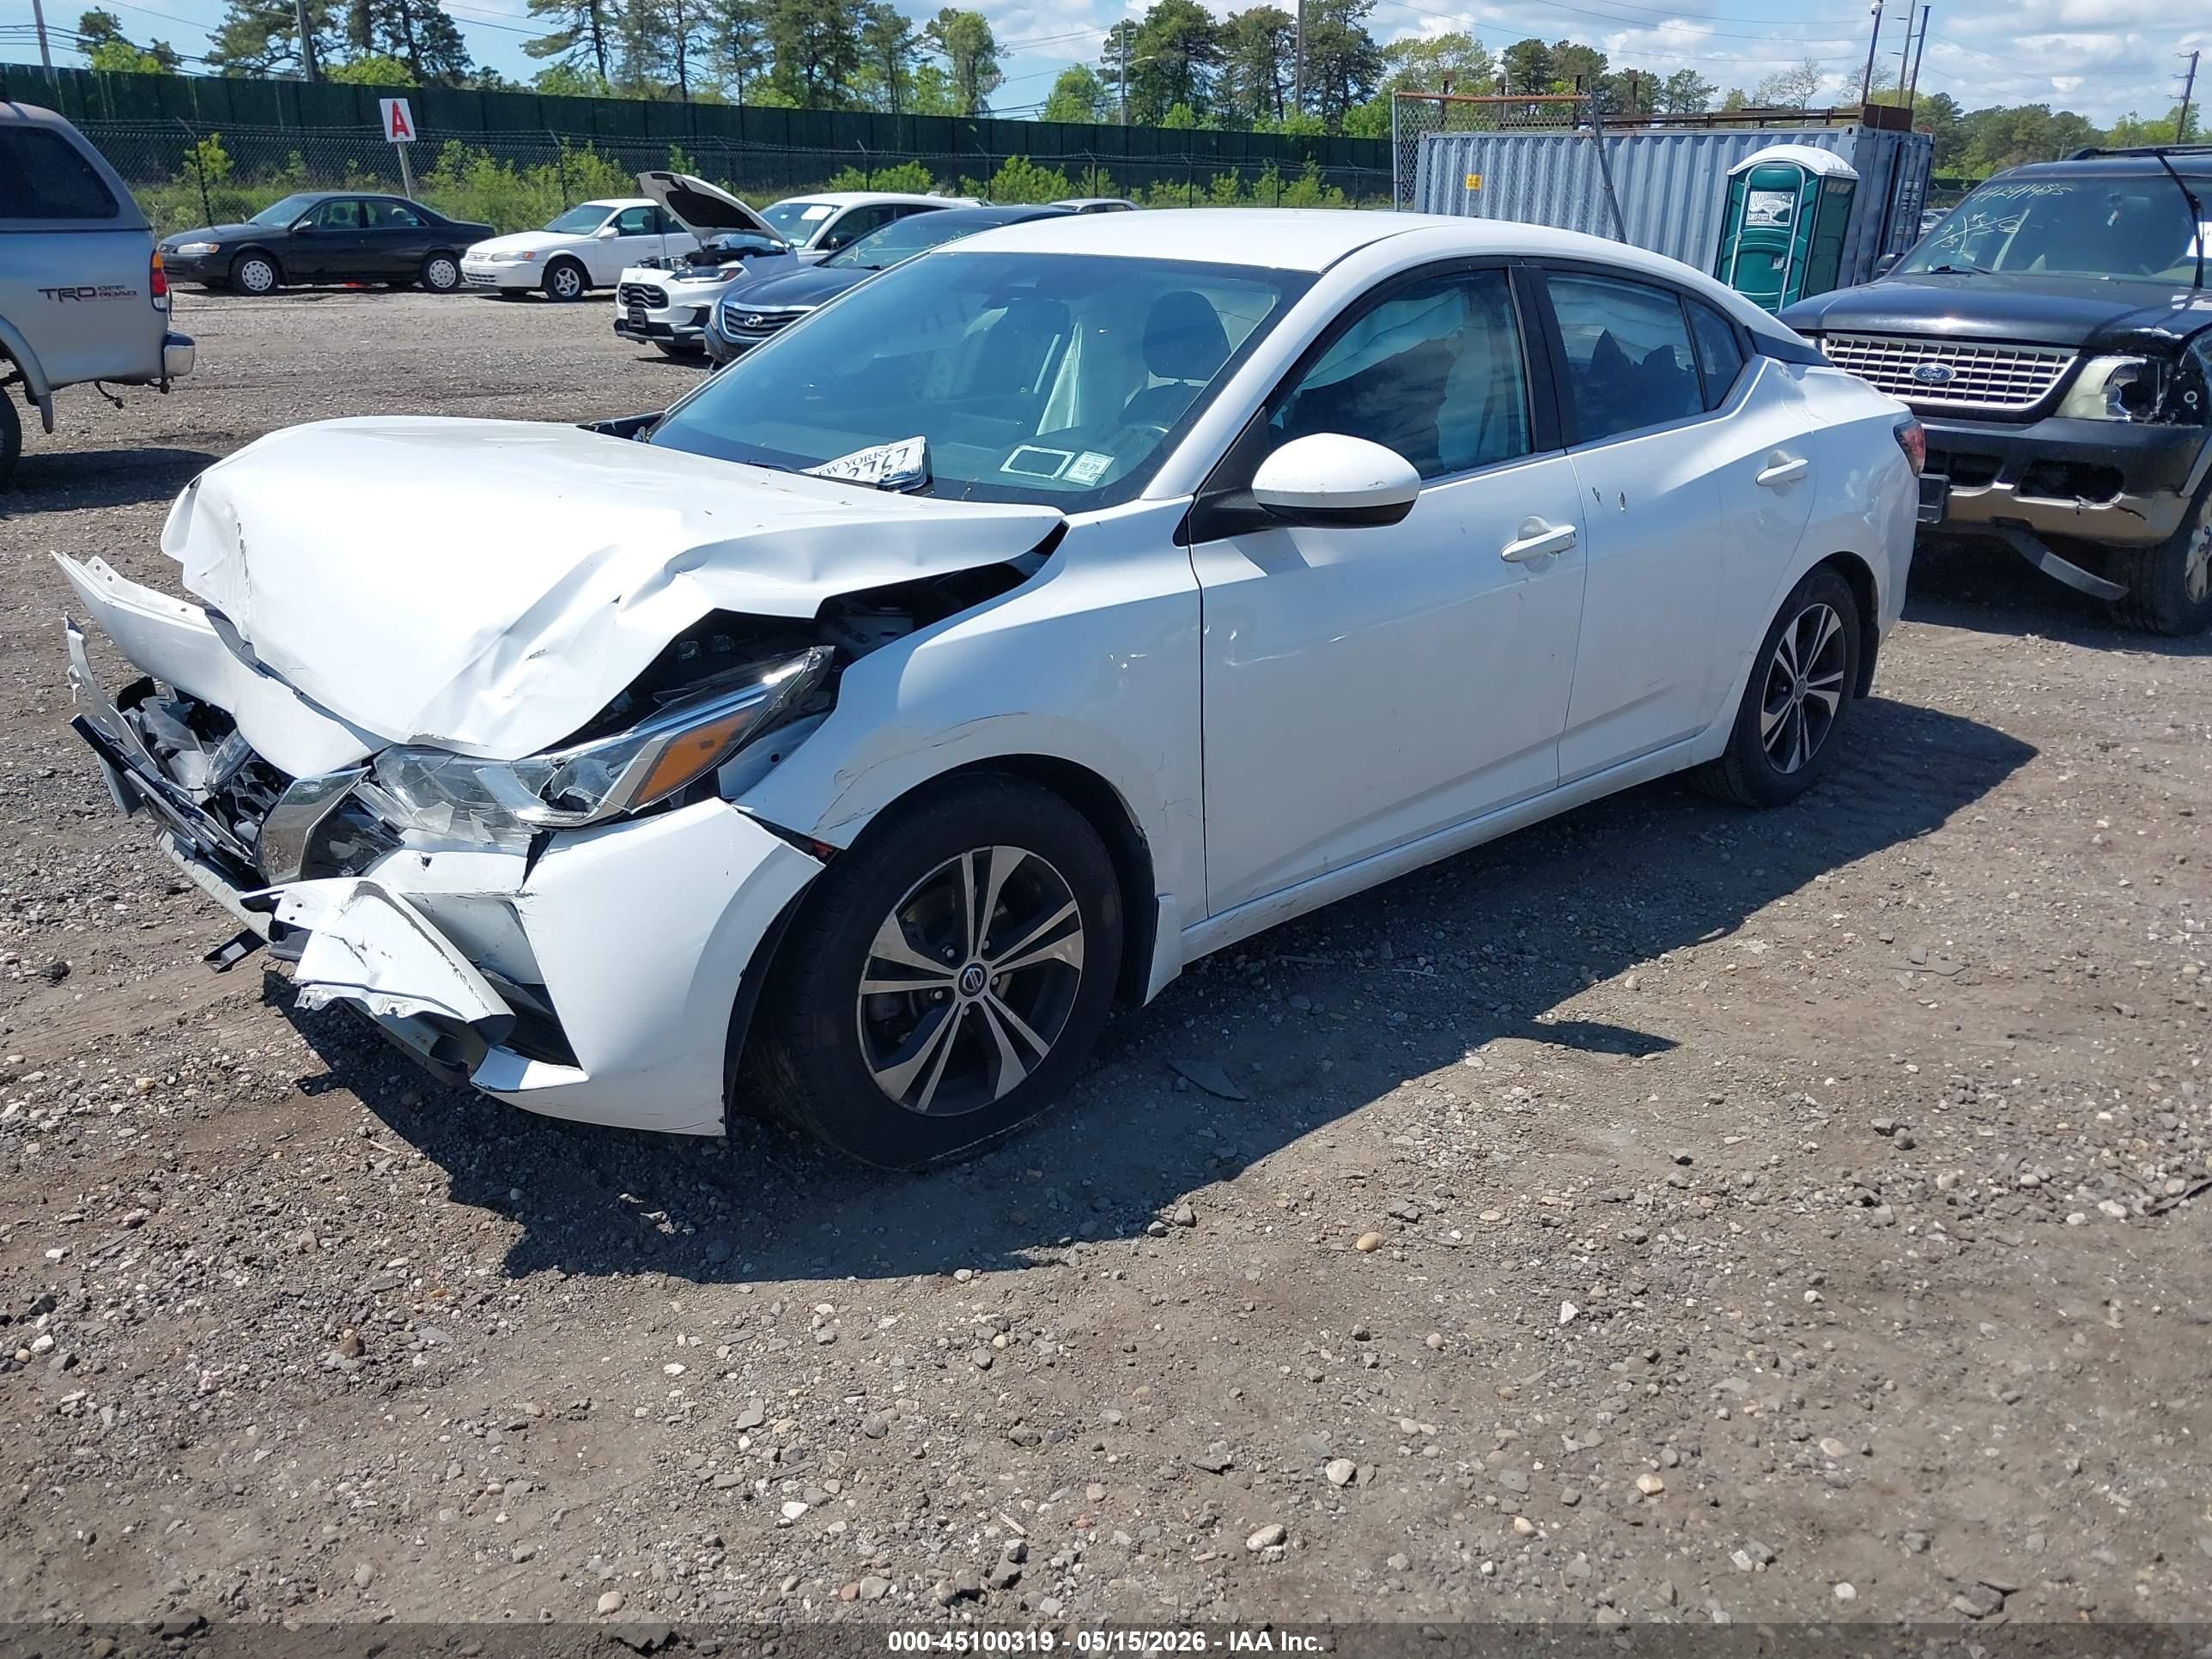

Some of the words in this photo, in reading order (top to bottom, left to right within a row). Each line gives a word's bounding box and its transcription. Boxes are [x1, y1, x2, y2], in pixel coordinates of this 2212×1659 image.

[392, 100, 410, 137] A
[37, 287, 96, 302] TRD
[843, 449, 892, 469] YORK
